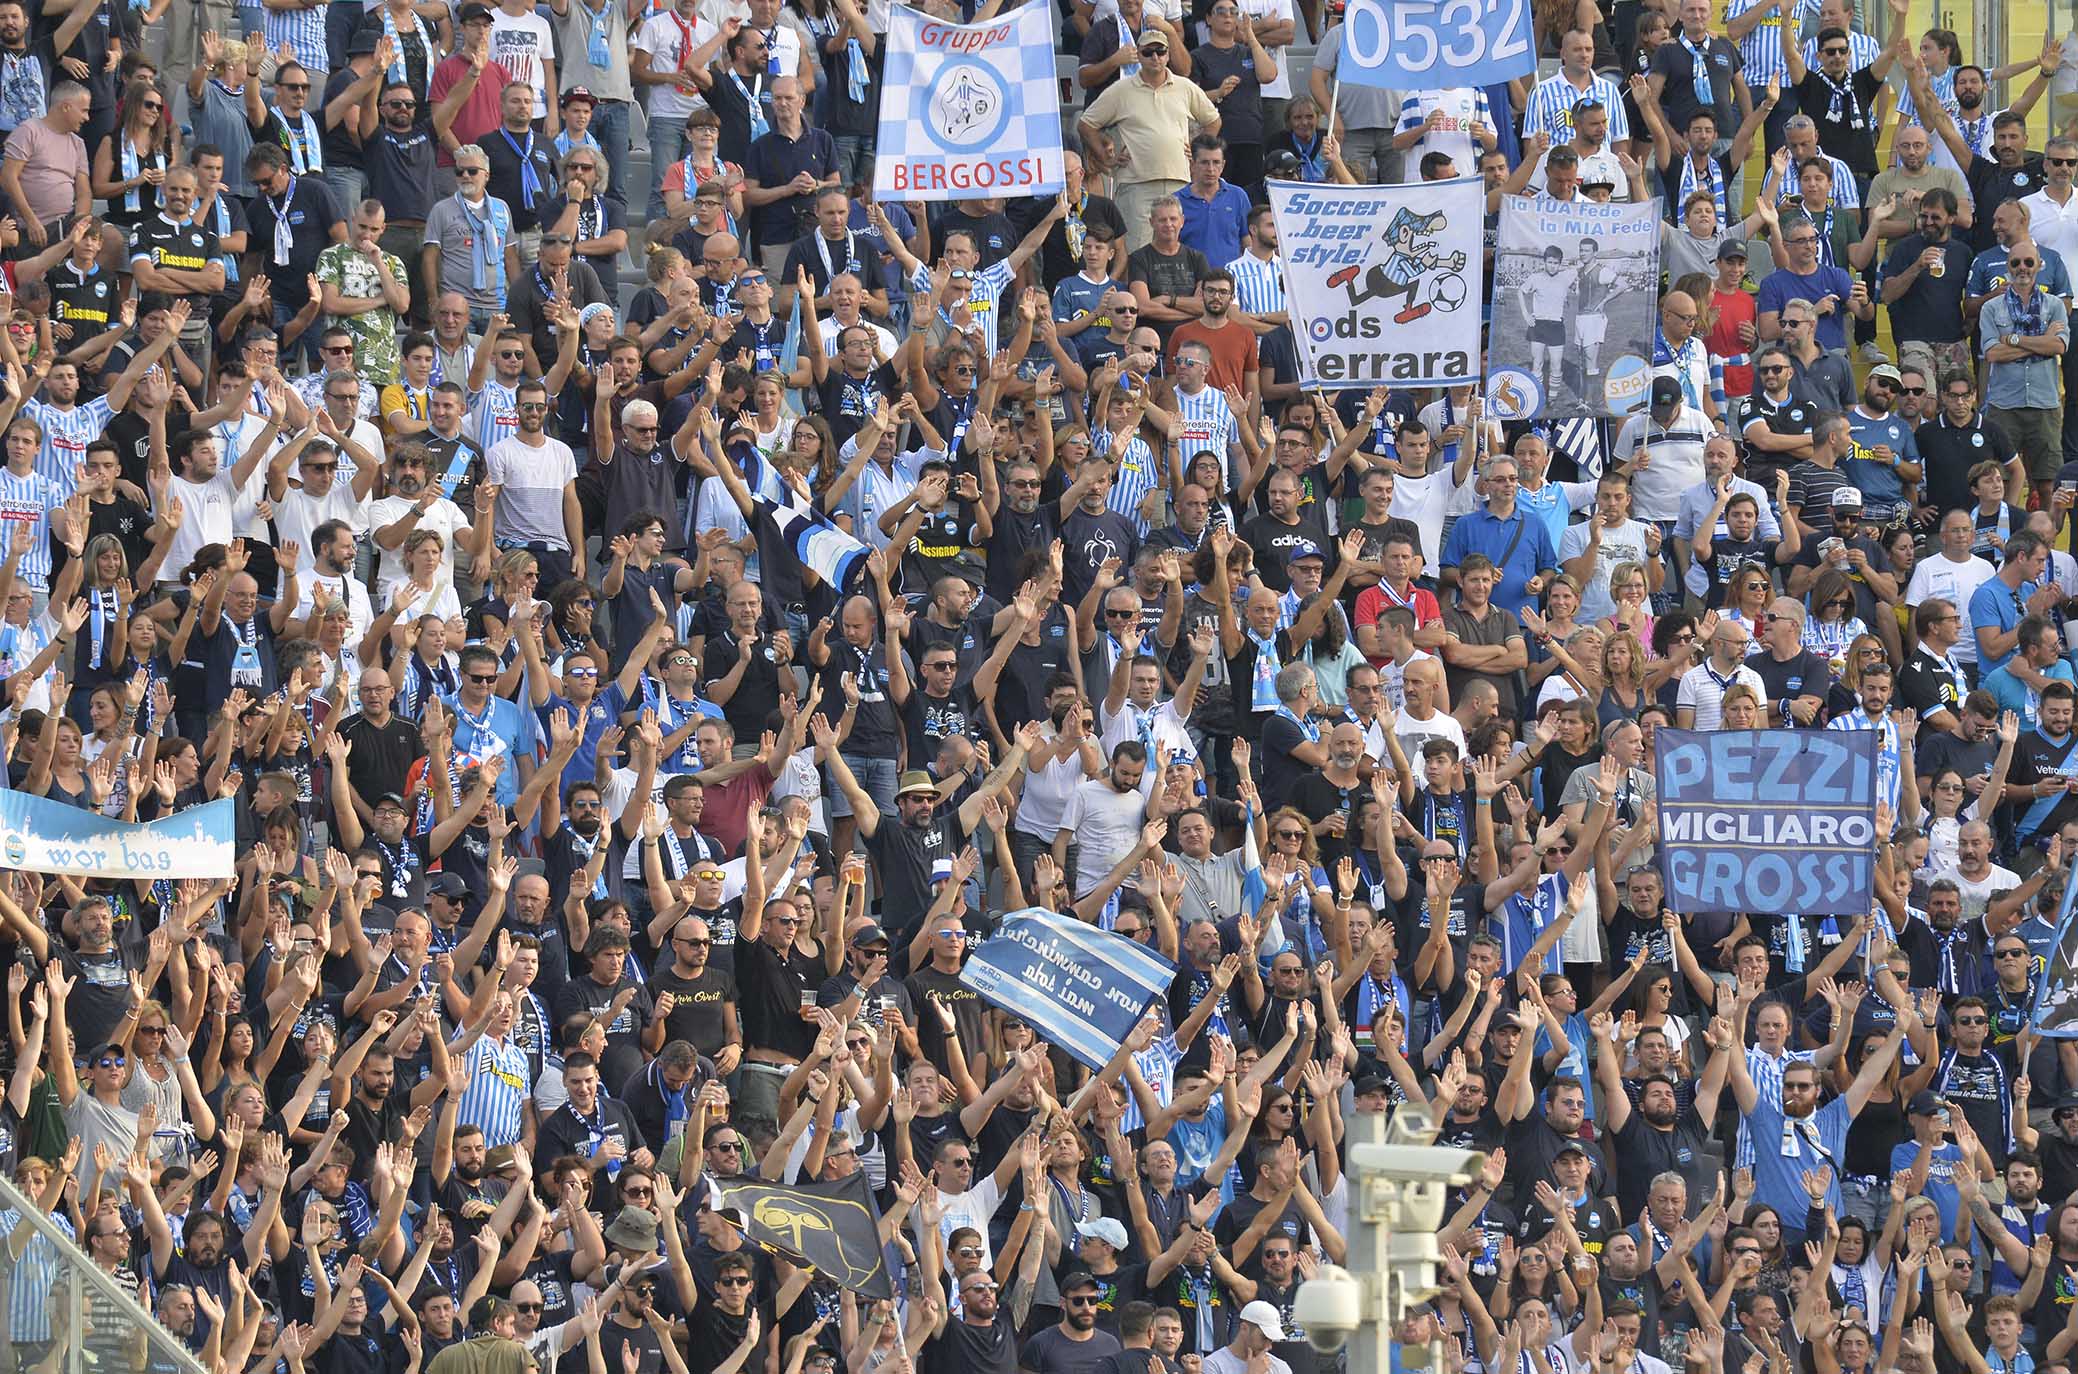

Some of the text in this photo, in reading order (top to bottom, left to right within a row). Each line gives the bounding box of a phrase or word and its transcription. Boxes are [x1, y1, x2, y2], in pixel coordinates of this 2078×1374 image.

[921, 22, 1011, 54] Gruppo
[1345, 0, 1529, 72] 0532
[893, 157, 1044, 190] BERGOSSI
[1284, 193, 1387, 216] Soccer
[1511, 198, 1528, 211] la
[1536, 198, 1571, 215] TUA
[1540, 218, 1652, 235] la MIA Fede
[1303, 310, 1382, 340] ods
[1311, 346, 1469, 381] errara
[440, 472, 470, 486] CARIFE
[1663, 732, 1870, 802] PEZZI
[2036, 765, 2072, 776] Vetrores
[1663, 811, 1874, 846] MIGLIARO
[1670, 850, 1866, 911] GROSSI
